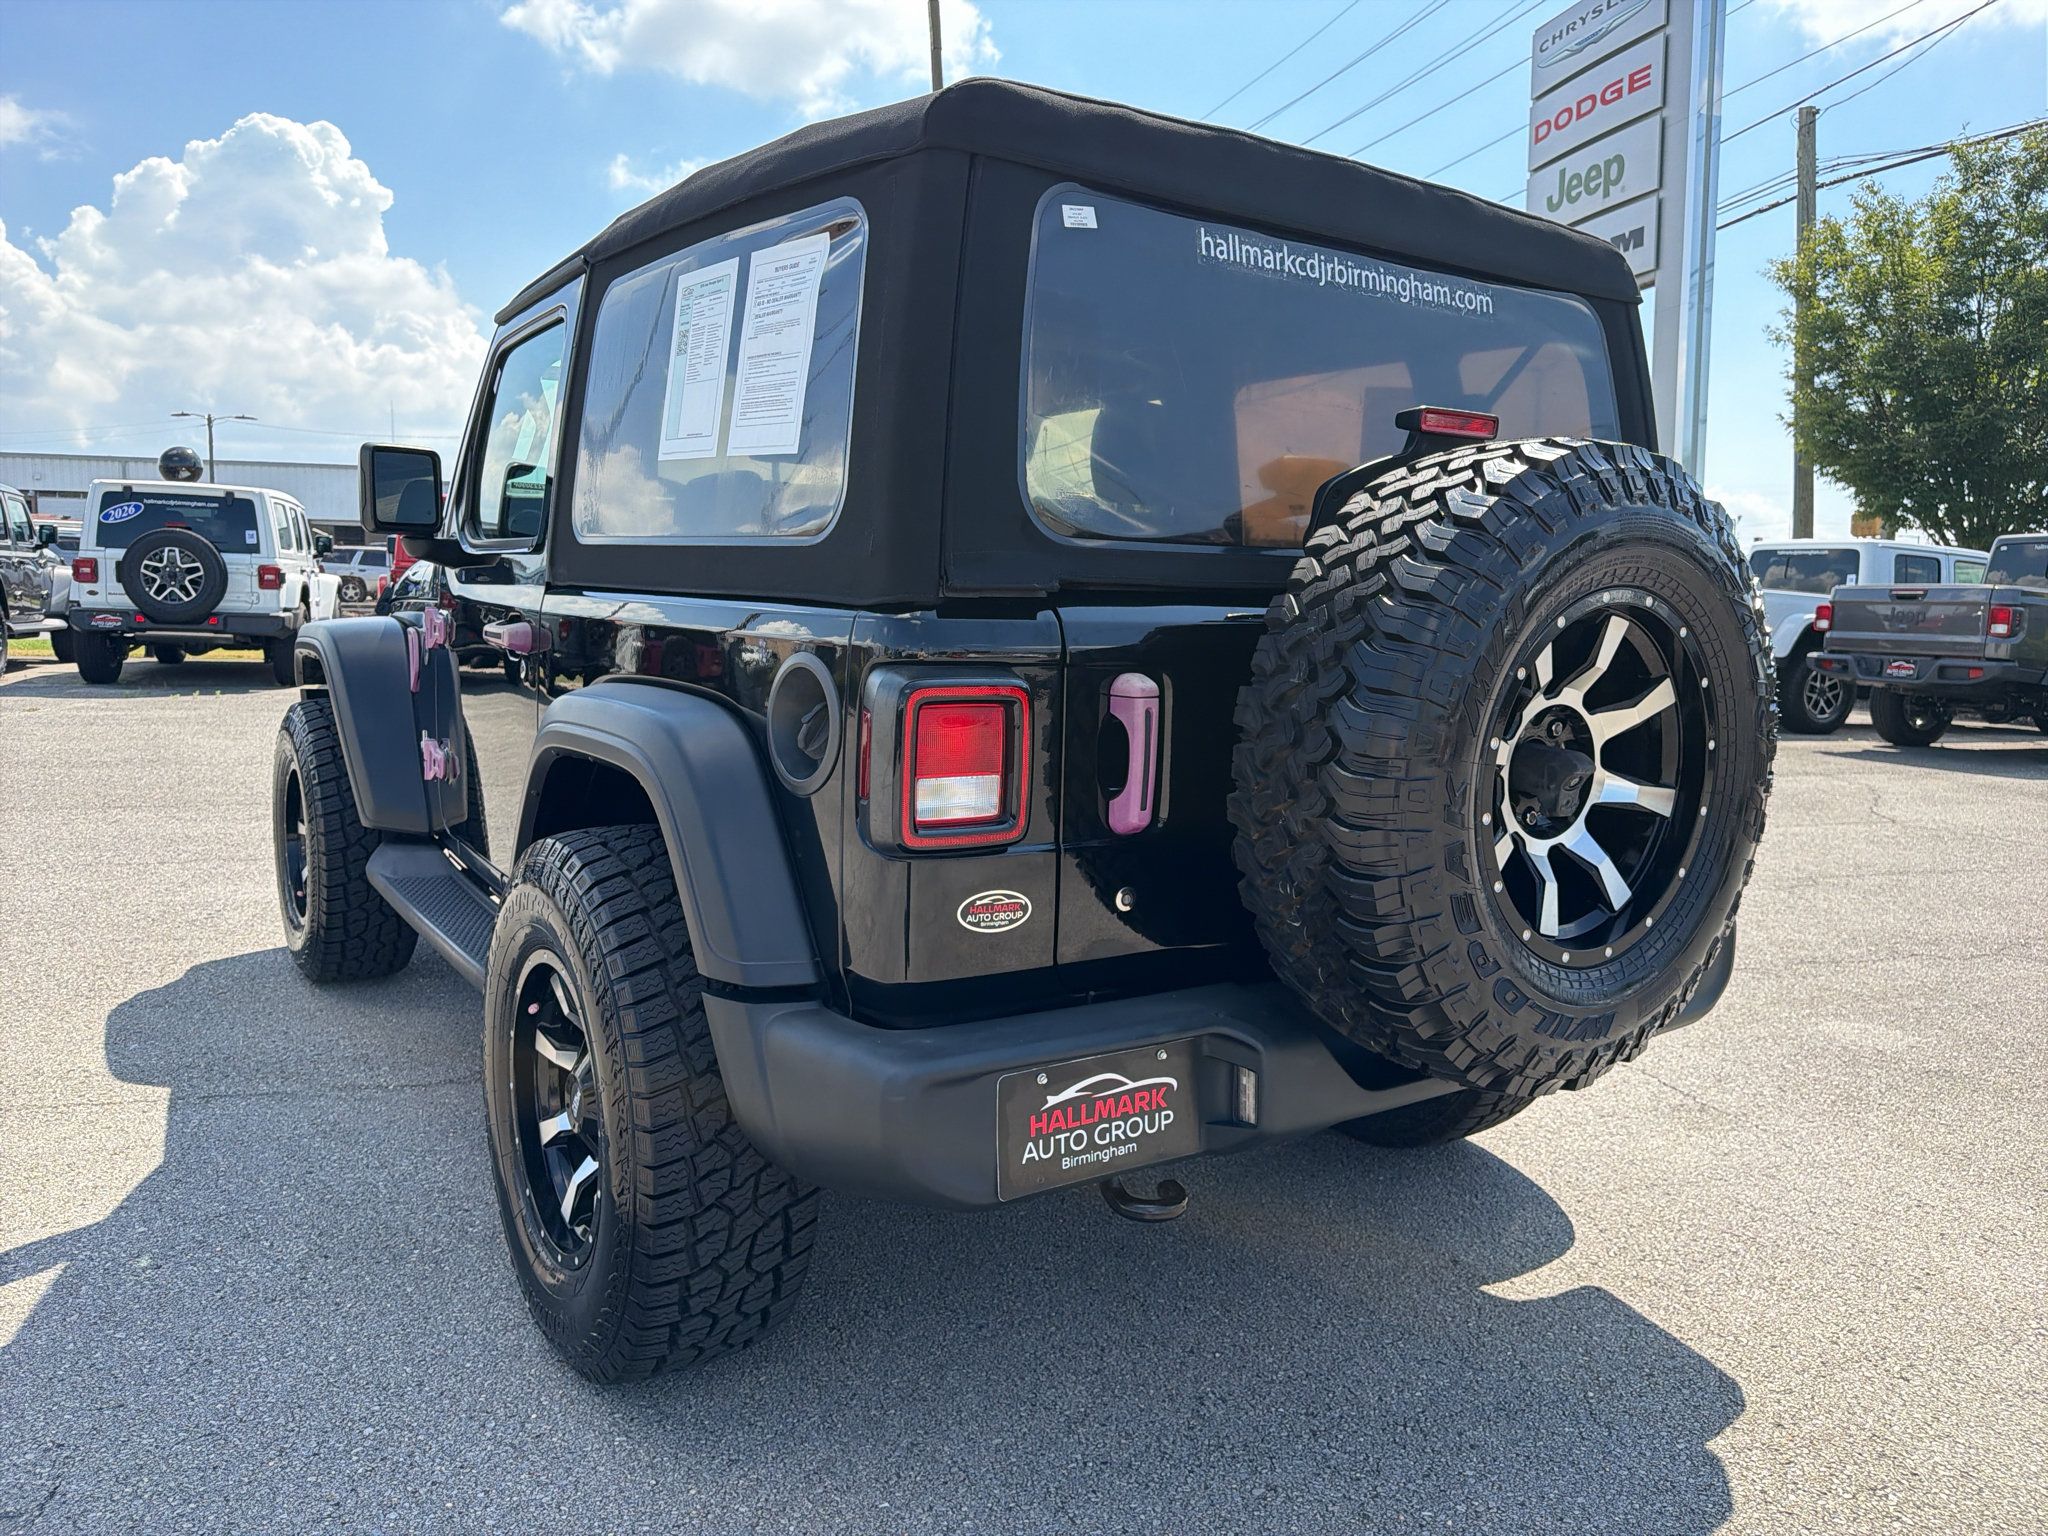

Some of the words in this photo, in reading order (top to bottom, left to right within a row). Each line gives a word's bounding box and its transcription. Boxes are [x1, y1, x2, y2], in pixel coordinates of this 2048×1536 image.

[1539, 0, 1628, 53] CHRYSL
[1534, 64, 1653, 145] DODGE
[1547, 153, 1625, 213] Jeep
[1198, 226, 1494, 315] hallmarkcdjrbirmingham.com
[109, 505, 136, 521] 2026
[1883, 606, 1926, 625] Jeep
[503, 891, 554, 930] COUNTRY
[966, 914, 988, 923] AUTO
[989, 910, 1024, 921] GROUP
[969, 902, 1022, 914] HALLMARK
[980, 919, 1009, 928] Birmingham
[1444, 771, 1616, 1042] WILDPEAK
[1029, 1087, 1168, 1138] HALLMARK
[1021, 1129, 1088, 1165] AUTO
[1094, 1110, 1174, 1145] GROUP
[1062, 1142, 1137, 1170] Birmingham
